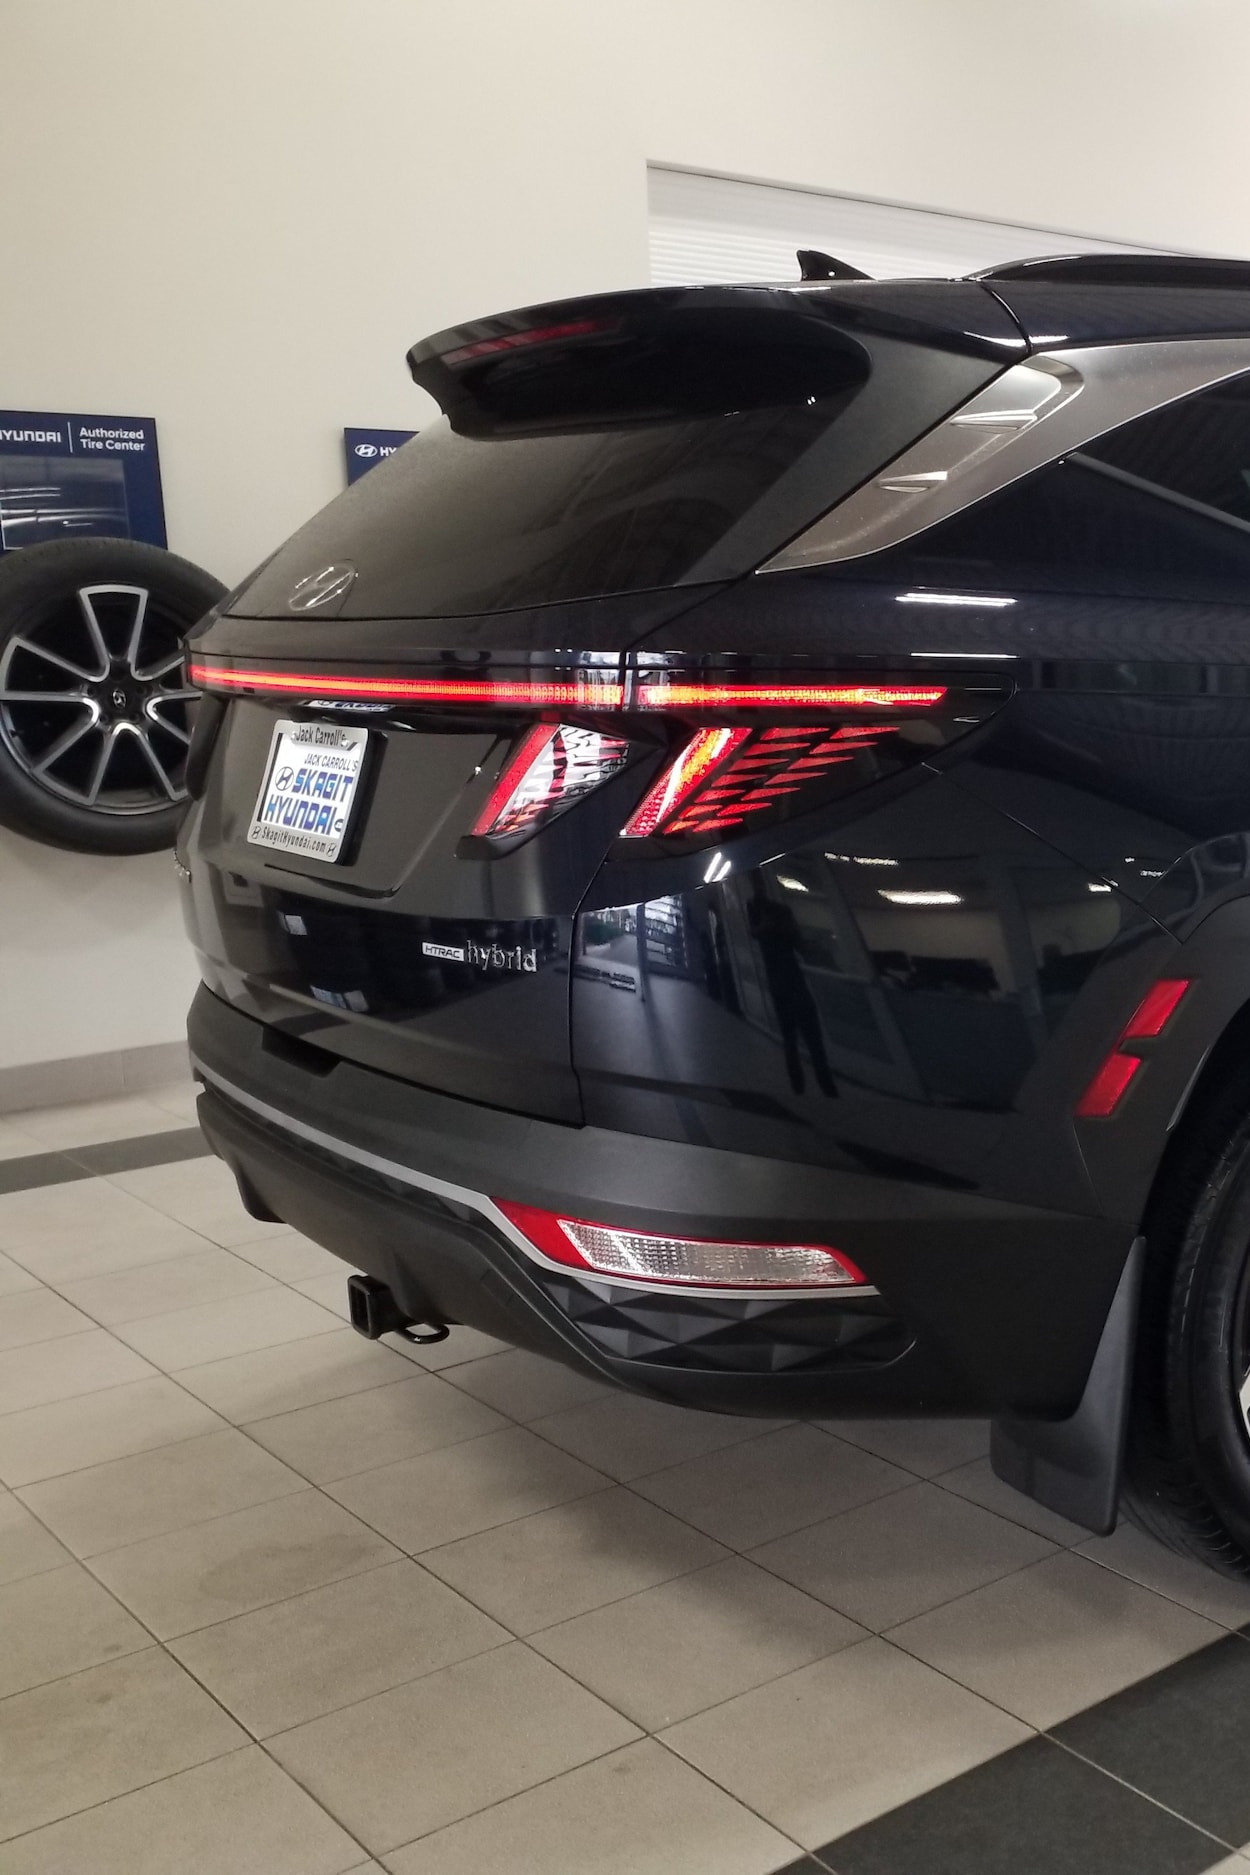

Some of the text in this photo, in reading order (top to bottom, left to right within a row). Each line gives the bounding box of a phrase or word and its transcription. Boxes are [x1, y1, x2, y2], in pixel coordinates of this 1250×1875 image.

[79, 427, 144, 440] Authorized
[80, 439, 145, 451] Tire Center
[295, 725, 347, 747] Jack Carroll's
[304, 753, 359, 772] JACK CARROLL'S
[291, 768, 354, 802] SKAGIT
[264, 794, 337, 835] HYUNDAI
[262, 826, 326, 852] SkagitHyundai.com
[424, 940, 537, 972] HTRAC hybrid
